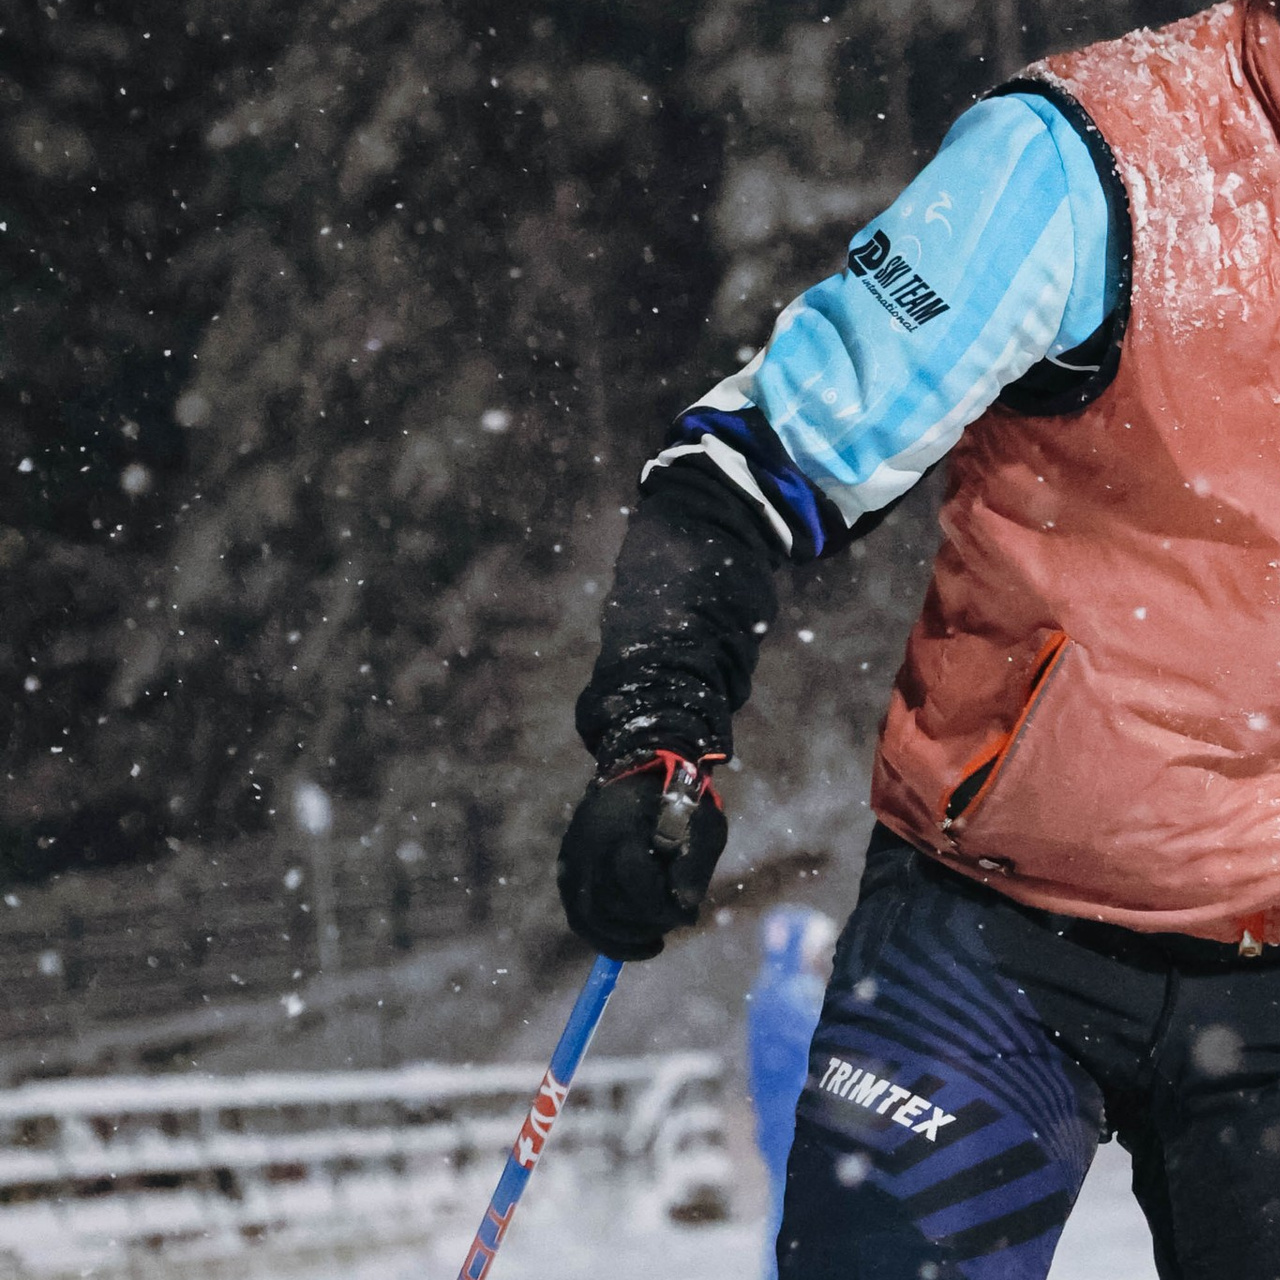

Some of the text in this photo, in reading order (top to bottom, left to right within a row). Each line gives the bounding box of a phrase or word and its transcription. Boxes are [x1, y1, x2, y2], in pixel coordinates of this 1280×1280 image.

[861, 278, 919, 333] international
[873, 255, 951, 326] SKI TEAM
[819, 1056, 957, 1143] TRIMTEX
